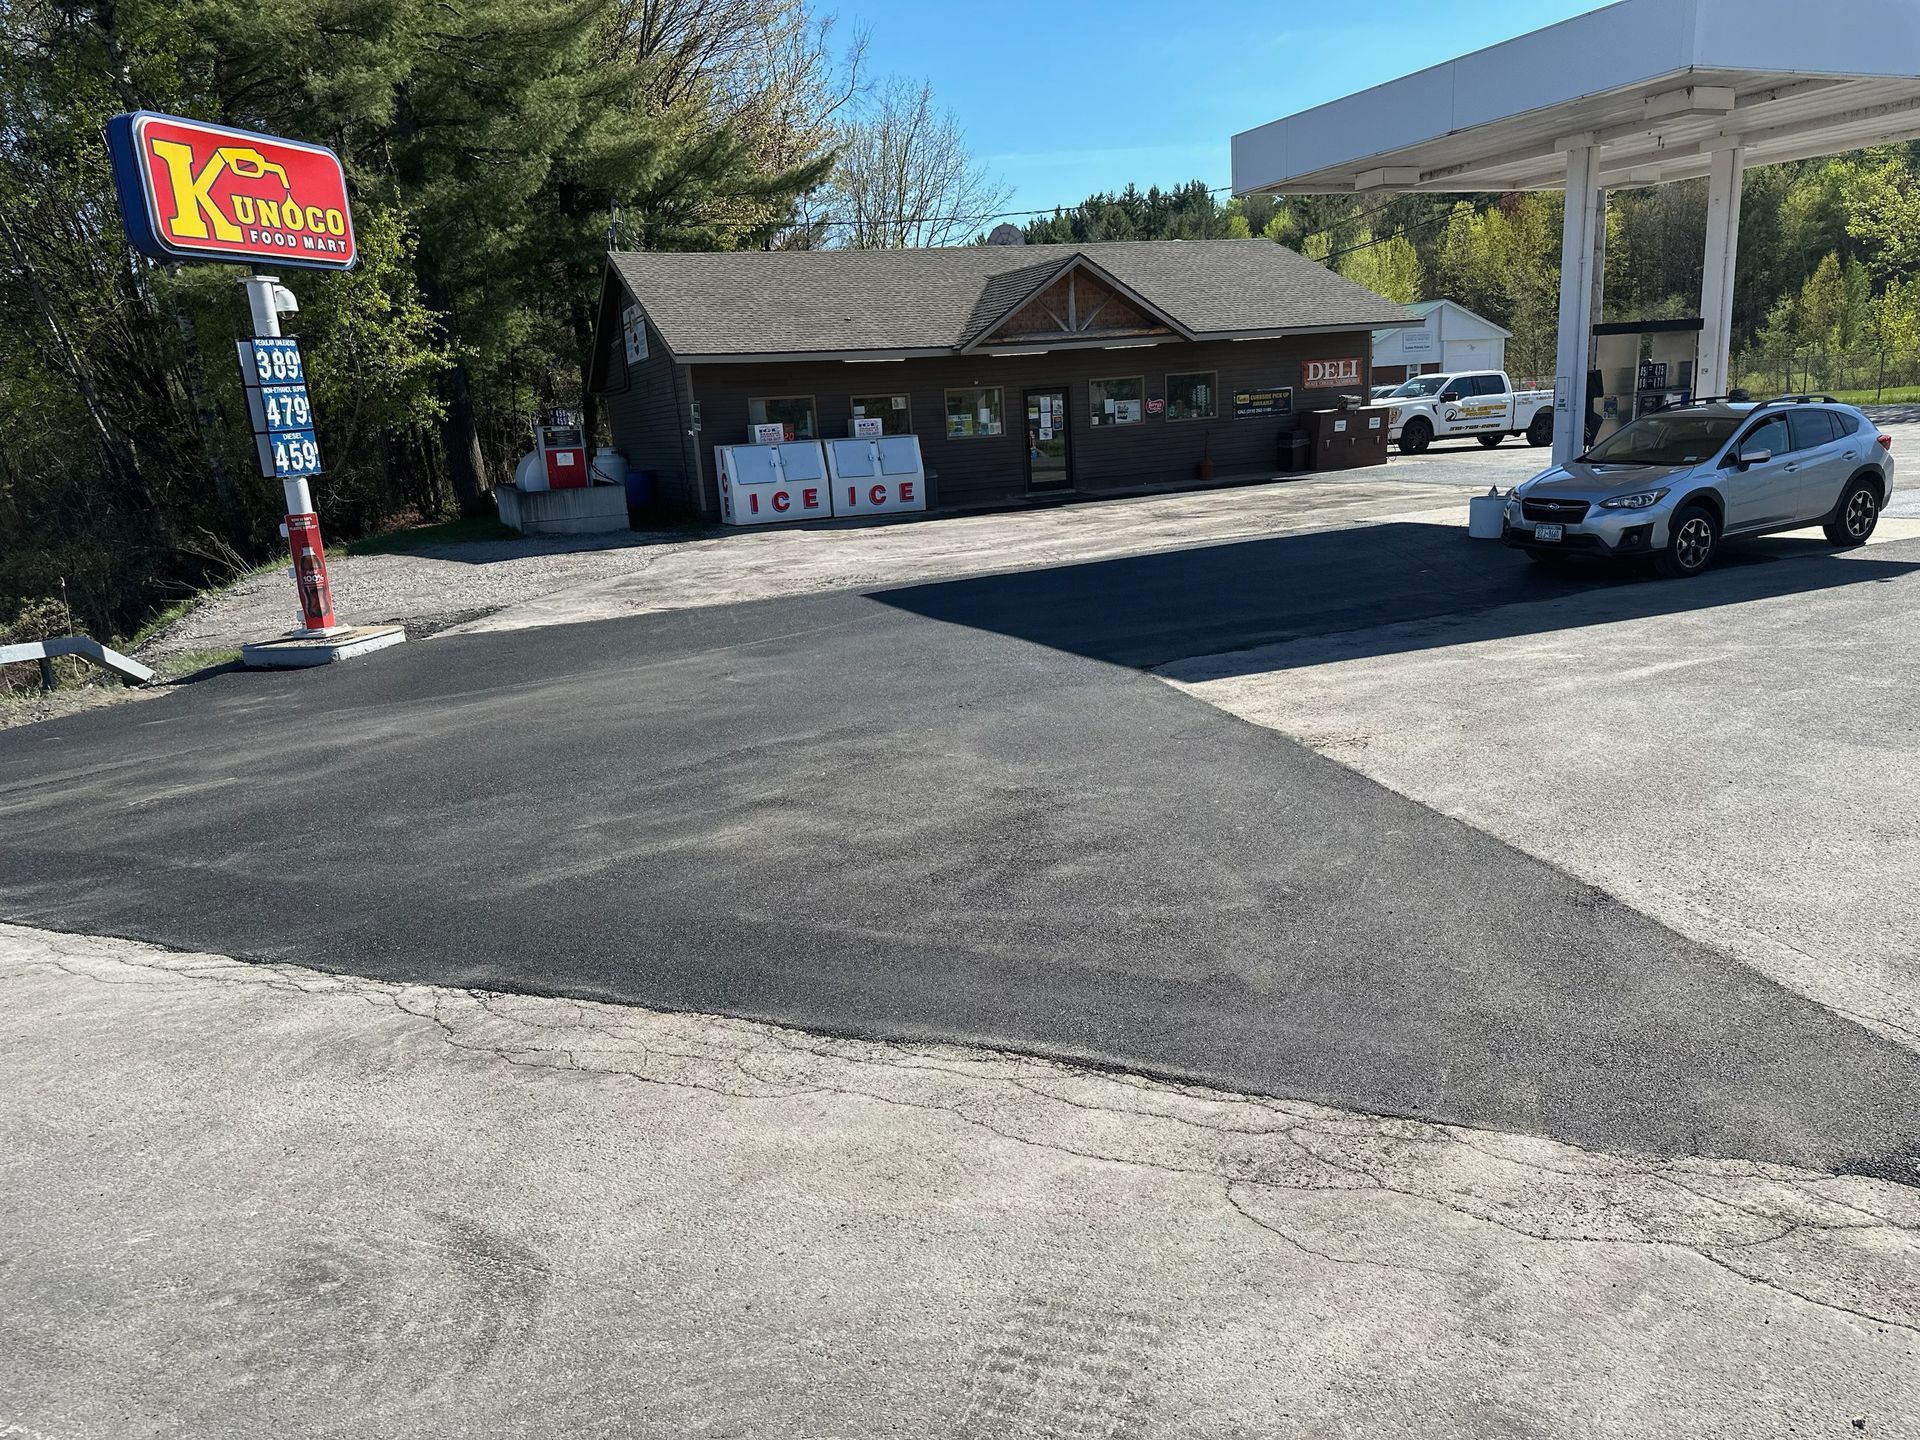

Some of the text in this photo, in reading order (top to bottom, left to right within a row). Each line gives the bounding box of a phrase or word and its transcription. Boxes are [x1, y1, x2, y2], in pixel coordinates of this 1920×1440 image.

[151, 138, 345, 243] KUNOCO
[250, 230, 347, 253] FOOD MART
[1307, 360, 1358, 381] DELI
[282, 432, 304, 441] DIESEL
[720, 448, 730, 517] ICE
[848, 482, 914, 506] ICE
[749, 488, 819, 514] ICE
